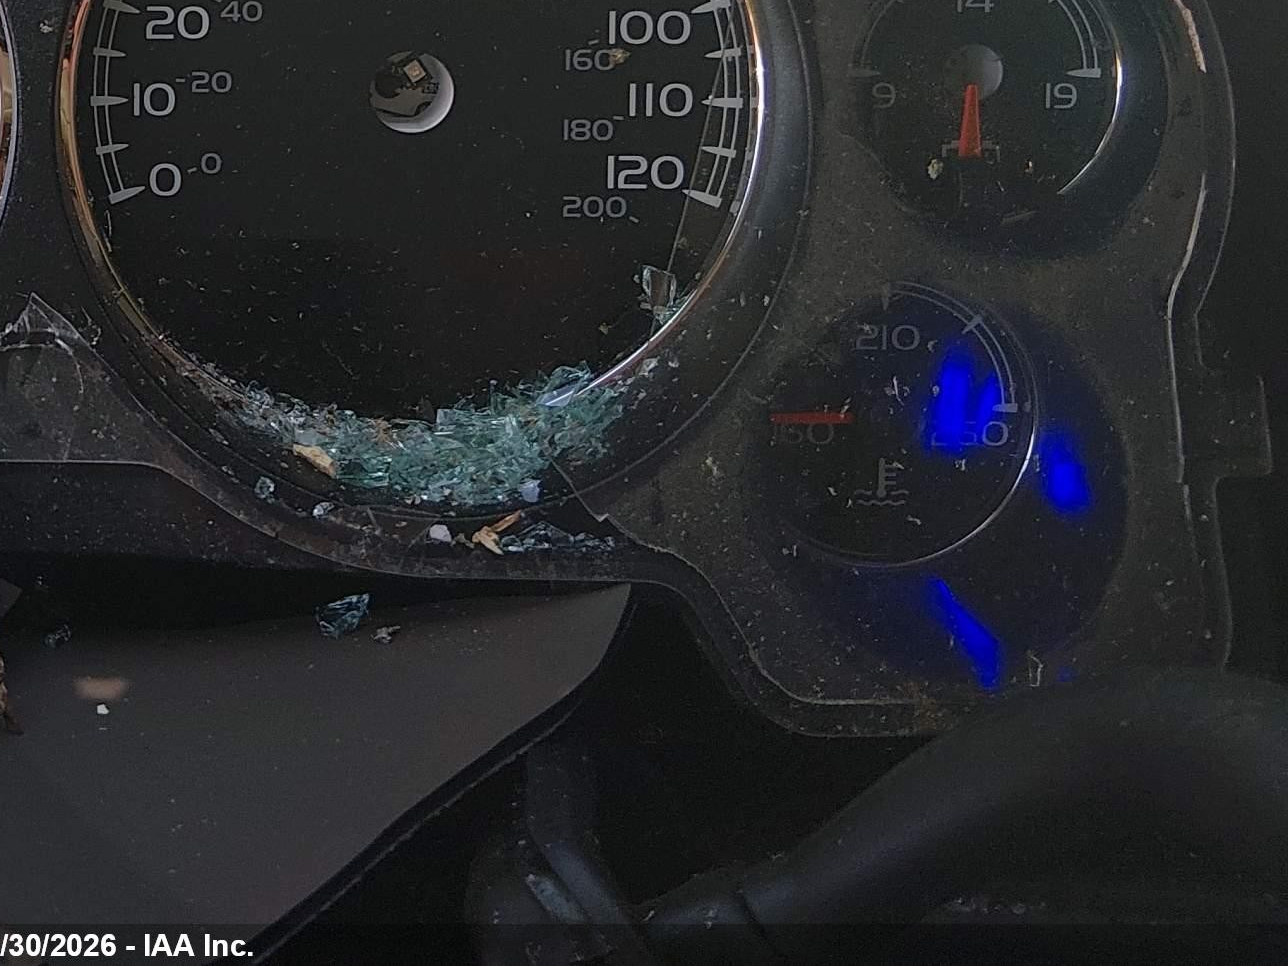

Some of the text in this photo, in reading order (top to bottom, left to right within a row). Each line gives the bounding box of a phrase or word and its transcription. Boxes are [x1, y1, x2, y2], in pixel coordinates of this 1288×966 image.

[145, 6, 210, 40] 20
[220, 1, 263, 22] 40
[609, 10, 691, 45] 100
[565, 49, 615, 71] 160
[191, 72, 232, 94] 20
[133, 83, 176, 117] 10
[628, 83, 694, 117] 110
[872, 84, 896, 108] 9
[1045, 84, 1078, 109] 19
[563, 119, 612, 141] 180
[201, 154, 222, 174] 0
[607, 156, 684, 189] 120
[149, 164, 182, 197] 0
[562, 197, 626, 218] 200
[856, 325, 920, 350] 210
